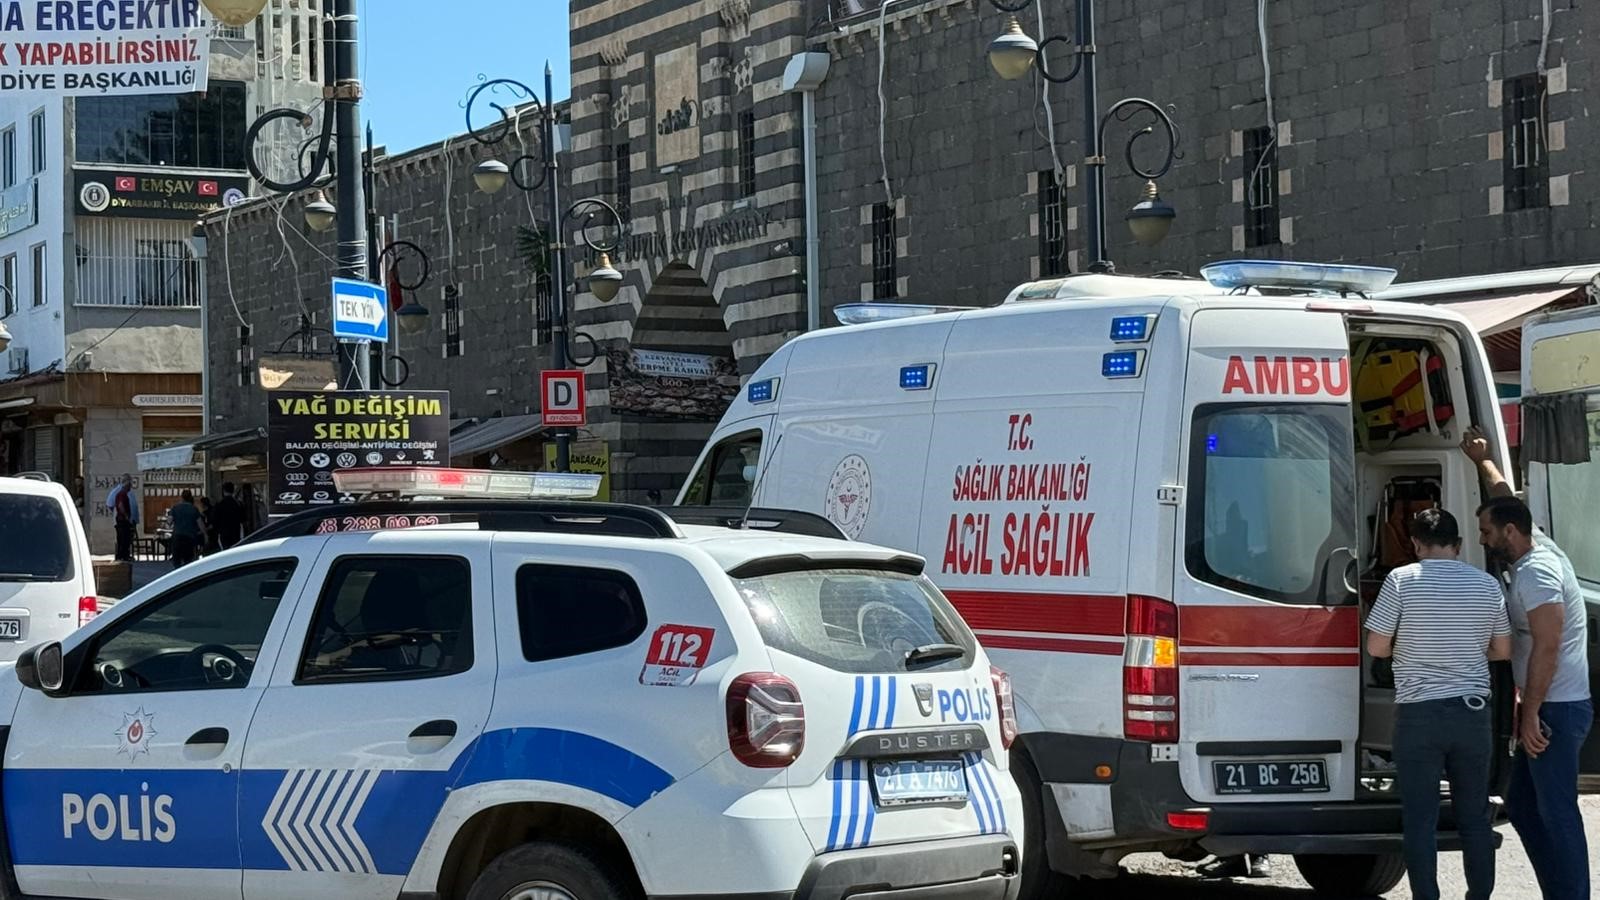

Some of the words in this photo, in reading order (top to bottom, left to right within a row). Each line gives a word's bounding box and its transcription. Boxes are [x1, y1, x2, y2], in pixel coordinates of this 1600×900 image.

[0, 2, 24, 31] A
[15, 34, 200, 66] YAPABİLİRSİNİZ.
[64, 66, 195, 92] BAŞKANLIĞI
[340, 300, 358, 318] TEK
[1222, 355, 1349, 396] AMBU
[277, 395, 327, 415] YAĞ
[335, 395, 441, 419] DEĞİŞİM
[554, 381, 572, 406] D
[314, 420, 410, 439] SERVİSİ
[1007, 413, 1034, 450] T.C.
[952, 457, 1005, 501] SAĞLIK
[1006, 455, 1092, 501] BAKANLIĞI
[1000, 504, 1096, 577] SAĞLIK
[659, 631, 702, 664] 112
[937, 678, 992, 722] POLİS
[879, 733, 975, 750] DUSTER
[881, 766, 904, 791] 21
[1226, 765, 1246, 786] 21
[1258, 765, 1279, 785] BC
[1289, 764, 1320, 785] 258
[62, 782, 177, 843] POLİS
